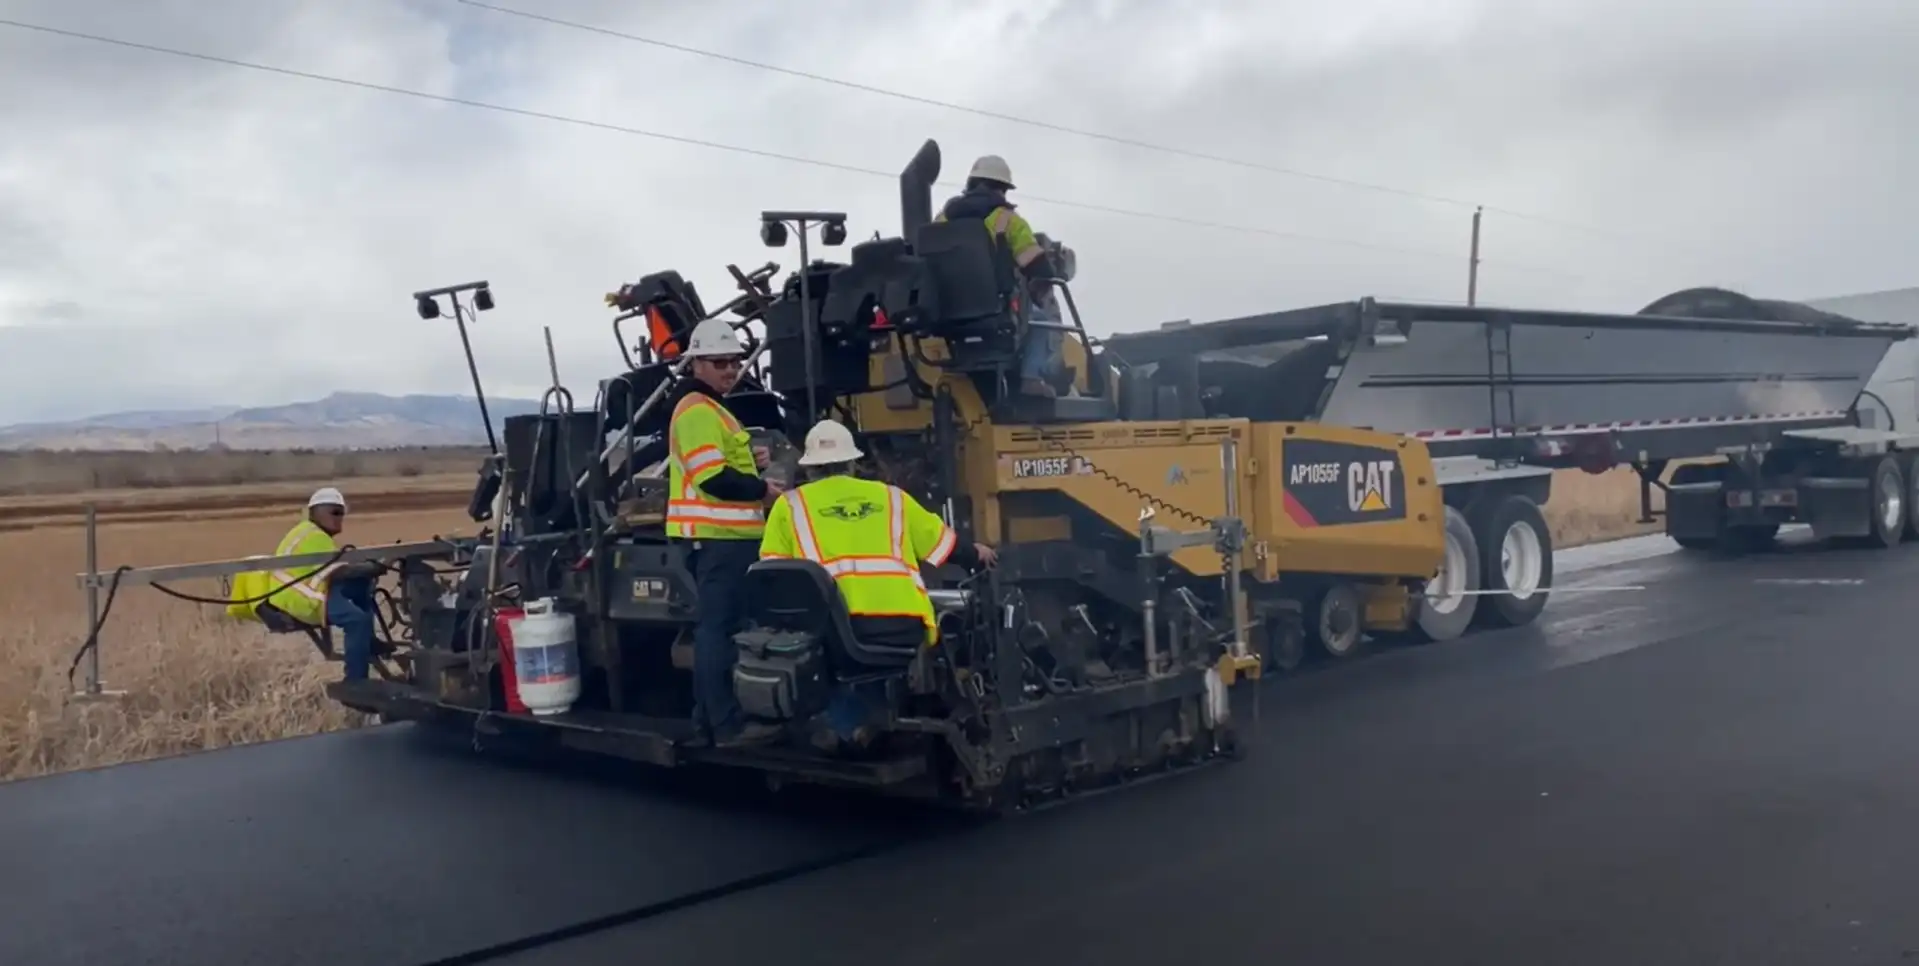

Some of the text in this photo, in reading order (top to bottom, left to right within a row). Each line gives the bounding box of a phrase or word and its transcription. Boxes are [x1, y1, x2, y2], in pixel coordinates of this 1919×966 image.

[1013, 458, 1069, 477] AP1055F
[1291, 462, 1340, 485] AP1055F
[1347, 460, 1395, 512] CAT
